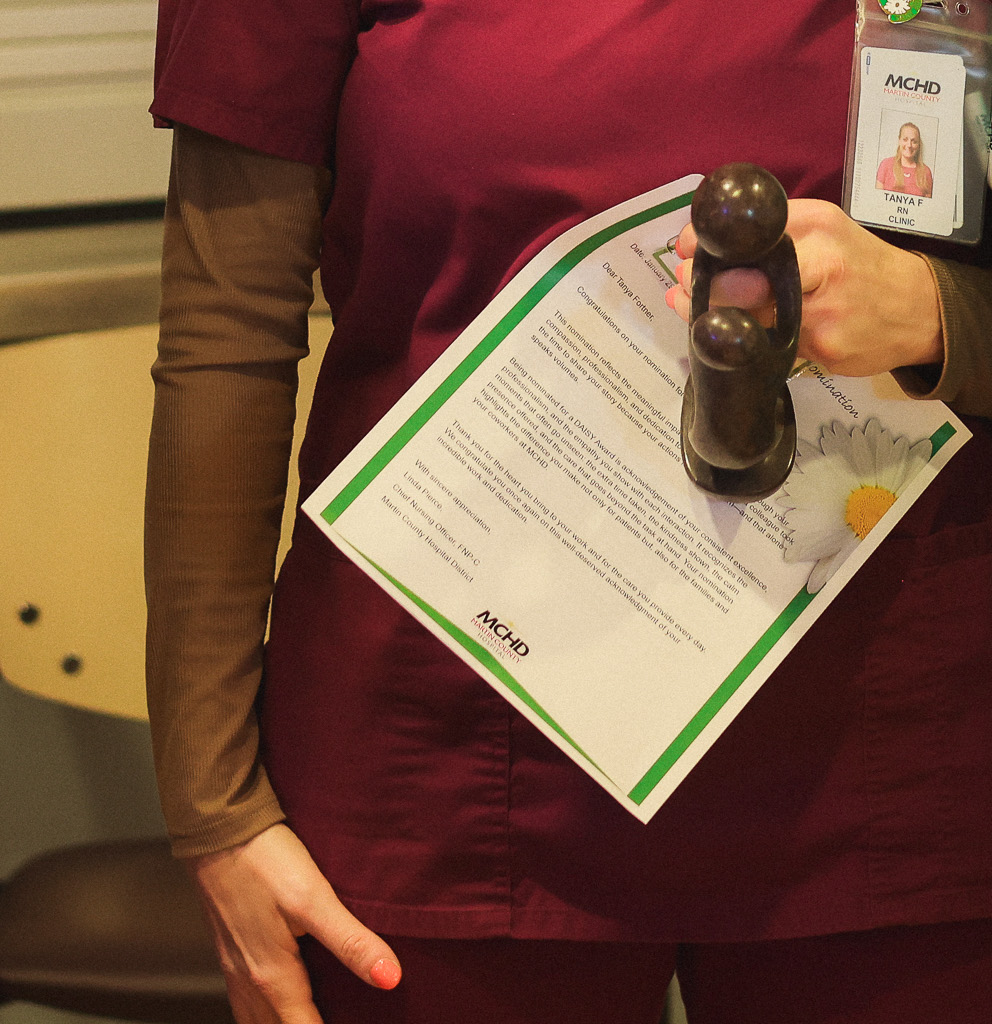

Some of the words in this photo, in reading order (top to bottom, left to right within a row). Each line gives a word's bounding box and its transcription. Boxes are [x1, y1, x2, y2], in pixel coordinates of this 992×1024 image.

[883, 87, 910, 97] MARTIN
[910, 92, 941, 103] COUNTY
[884, 73, 941, 95] MCHD
[883, 192, 916, 206] TANYA
[917, 198, 923, 206] F
[888, 214, 915, 227] CLINIC
[896, 206, 909, 215] RN
[601, 261, 618, 279] Dear
[615, 276, 634, 298] Tanya
[643, 257, 666, 282] January
[529, 333, 554, 358] speaks
[575, 285, 621, 334] Congratulations
[619, 332, 630, 343] on
[627, 340, 643, 356] your
[642, 354, 676, 388] nomination
[674, 385, 686, 397] for
[808, 364, 859, 418] omination
[471, 396, 488, 412] your
[486, 410, 519, 442] coworkers
[518, 439, 527, 449] at
[537, 325, 550, 338] the
[548, 335, 563, 352] time
[561, 348, 571, 359] to
[568, 356, 588, 376] share
[585, 373, 602, 390] your
[600, 387, 618, 405] story
[615, 401, 644, 429] because
[641, 427, 658, 443] your
[656, 440, 683, 463] actions
[751, 520, 766, 534] that
[765, 532, 784, 549] alone
[553, 309, 568, 326] This
[565, 323, 600, 358] nomination
[598, 355, 622, 379] reflects
[620, 376, 632, 390] the
[630, 387, 666, 422] meaningful
[772, 511, 789, 528] your
[402, 470, 422, 490] Linda
[414, 458, 430, 476] With
[428, 473, 453, 497] sincere
[436, 434, 467, 466] incredible
[465, 463, 482, 481] work
[481, 478, 496, 493] and
[493, 372, 524, 402] moments
[522, 399, 537, 414] that
[534, 412, 552, 430] often
[549, 427, 561, 439] go
[584, 458, 597, 471] the
[596, 469, 614, 486] extra
[612, 483, 629, 499] time
[647, 514, 660, 527] the
[658, 523, 689, 552] kindness
[710, 568, 724, 581] the
[722, 579, 740, 595] calm
[508, 356, 528, 378] Being
[526, 374, 561, 408] nominated
[558, 404, 569, 416] for
[572, 418, 596, 441] DAISY
[593, 438, 616, 460] Award
[614, 456, 622, 466] is
[620, 463, 679, 515] acknowledgement
[677, 512, 687, 521] of
[683, 518, 701, 534] your
[699, 531, 734, 562] consistent
[629, 401, 644, 415] and
[641, 412, 675, 444] dedication
[748, 504, 780, 532] colleague
[779, 530, 795, 545] took
[479, 387, 510, 419] highlights
[508, 415, 521, 429] the
[519, 426, 551, 457] difference
[548, 455, 563, 469] you
[561, 466, 581, 485] make
[579, 482, 593, 496] not
[590, 493, 607, 509] only
[605, 505, 616, 516] for
[613, 514, 642, 539] patients
[653, 548, 669, 563] also
[667, 559, 679, 571] for
[677, 568, 691, 581] the
[689, 578, 715, 603] families
[714, 600, 730, 614] and
[485, 380, 516, 410] presence
[538, 430, 553, 445] and
[551, 441, 564, 455] the
[562, 452, 578, 468] care
[576, 465, 592, 480] that
[588, 477, 607, 495] goes
[605, 491, 632, 516] beyond
[629, 512, 643, 525] the
[641, 522, 657, 538] task
[655, 535, 665, 545] at
[682, 557, 699, 574] Your
[697, 571, 734, 604] nomination
[549, 411, 564, 426] and
[561, 422, 574, 436] the
[572, 433, 601, 461] empathy
[598, 458, 613, 472] you
[612, 469, 631, 487] show
[629, 484, 645, 500] with
[643, 497, 661, 514] each
[700, 546, 737, 579] recognizes
[735, 575, 748, 588] the
[380, 494, 402, 516] Martin
[400, 513, 426, 538] County
[423, 534, 452, 563] Hospital
[449, 558, 474, 583] District
[391, 482, 411, 502] Chief
[408, 498, 435, 526] Nursing
[456, 542, 481, 566] FNP-C
[443, 426, 456, 441] We
[454, 438, 494, 477] congratulate
[491, 474, 506, 489] you
[504, 486, 522, 503] once
[520, 501, 541, 520] again
[539, 517, 550, 528] on
[548, 525, 562, 539] this
[560, 536, 606, 578] well-deserved
[604, 575, 659, 625] acknowledgment
[657, 622, 667, 631] of
[663, 628, 681, 645] your
[451, 419, 472, 441] Thank
[469, 439, 484, 453] you
[482, 449, 494, 461] for
[492, 458, 505, 472] the
[502, 468, 522, 488] heart
[518, 485, 534, 500] you
[531, 496, 550, 515] bring
[548, 511, 558, 521] to
[555, 518, 572, 535] your
[571, 531, 588, 549] work
[587, 546, 602, 560] and
[600, 557, 612, 569] for
[610, 566, 623, 579] the
[621, 577, 638, 592] care
[635, 589, 651, 604] you
[648, 601, 675, 625] provide
[673, 622, 693, 641] every
[469, 616, 496, 641] MARTIN
[492, 637, 521, 665] COUNTY
[476, 610, 530, 657] MCHD
[476, 631, 506, 659] HOSPITAL
